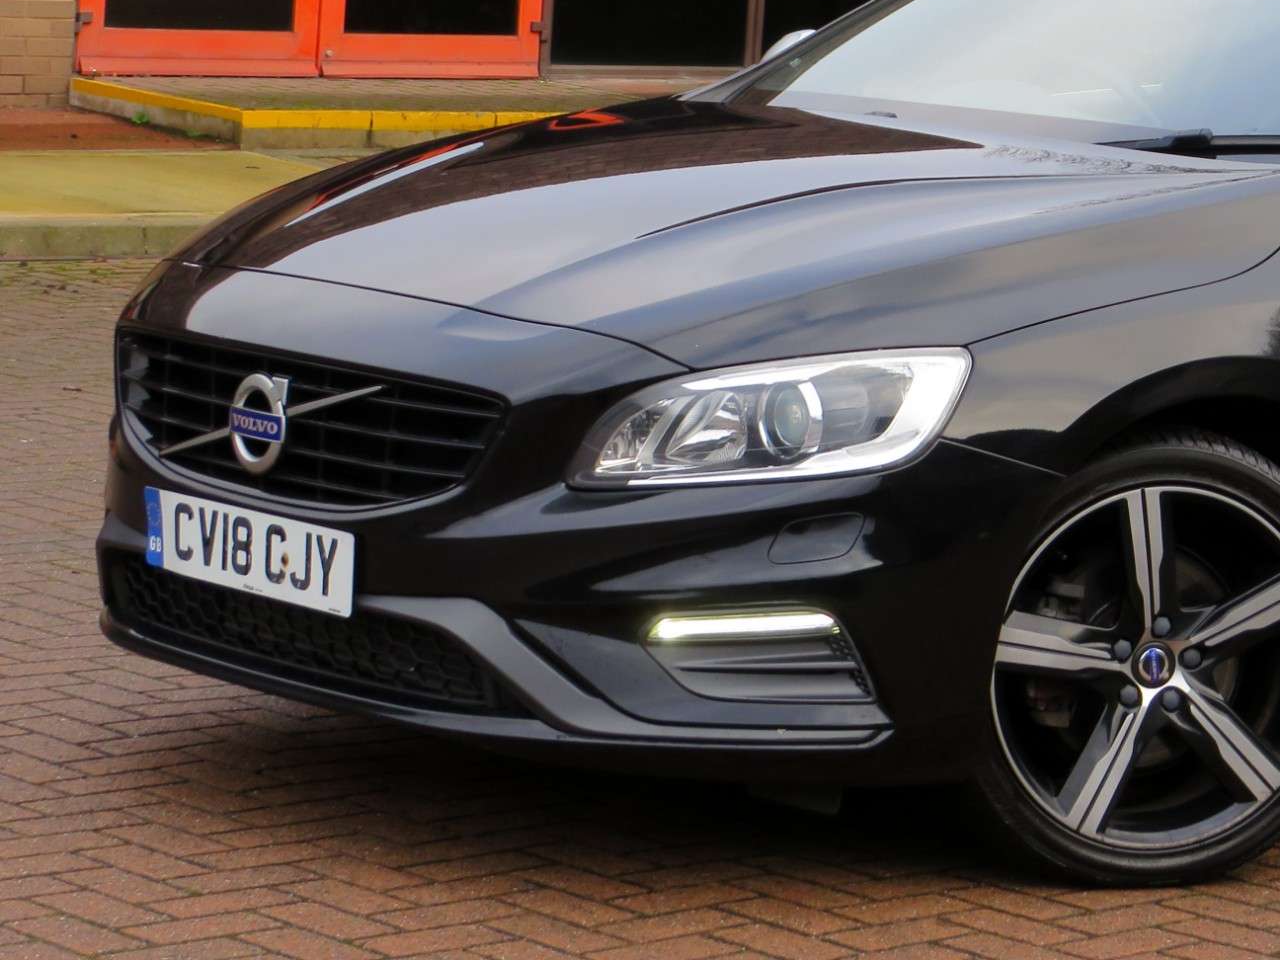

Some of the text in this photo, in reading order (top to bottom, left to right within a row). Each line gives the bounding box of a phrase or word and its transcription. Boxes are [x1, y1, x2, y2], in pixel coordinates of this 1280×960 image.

[232, 413, 278, 435] VOLVO
[150, 535, 161, 552] GB
[174, 502, 338, 597] CV18 CJY
